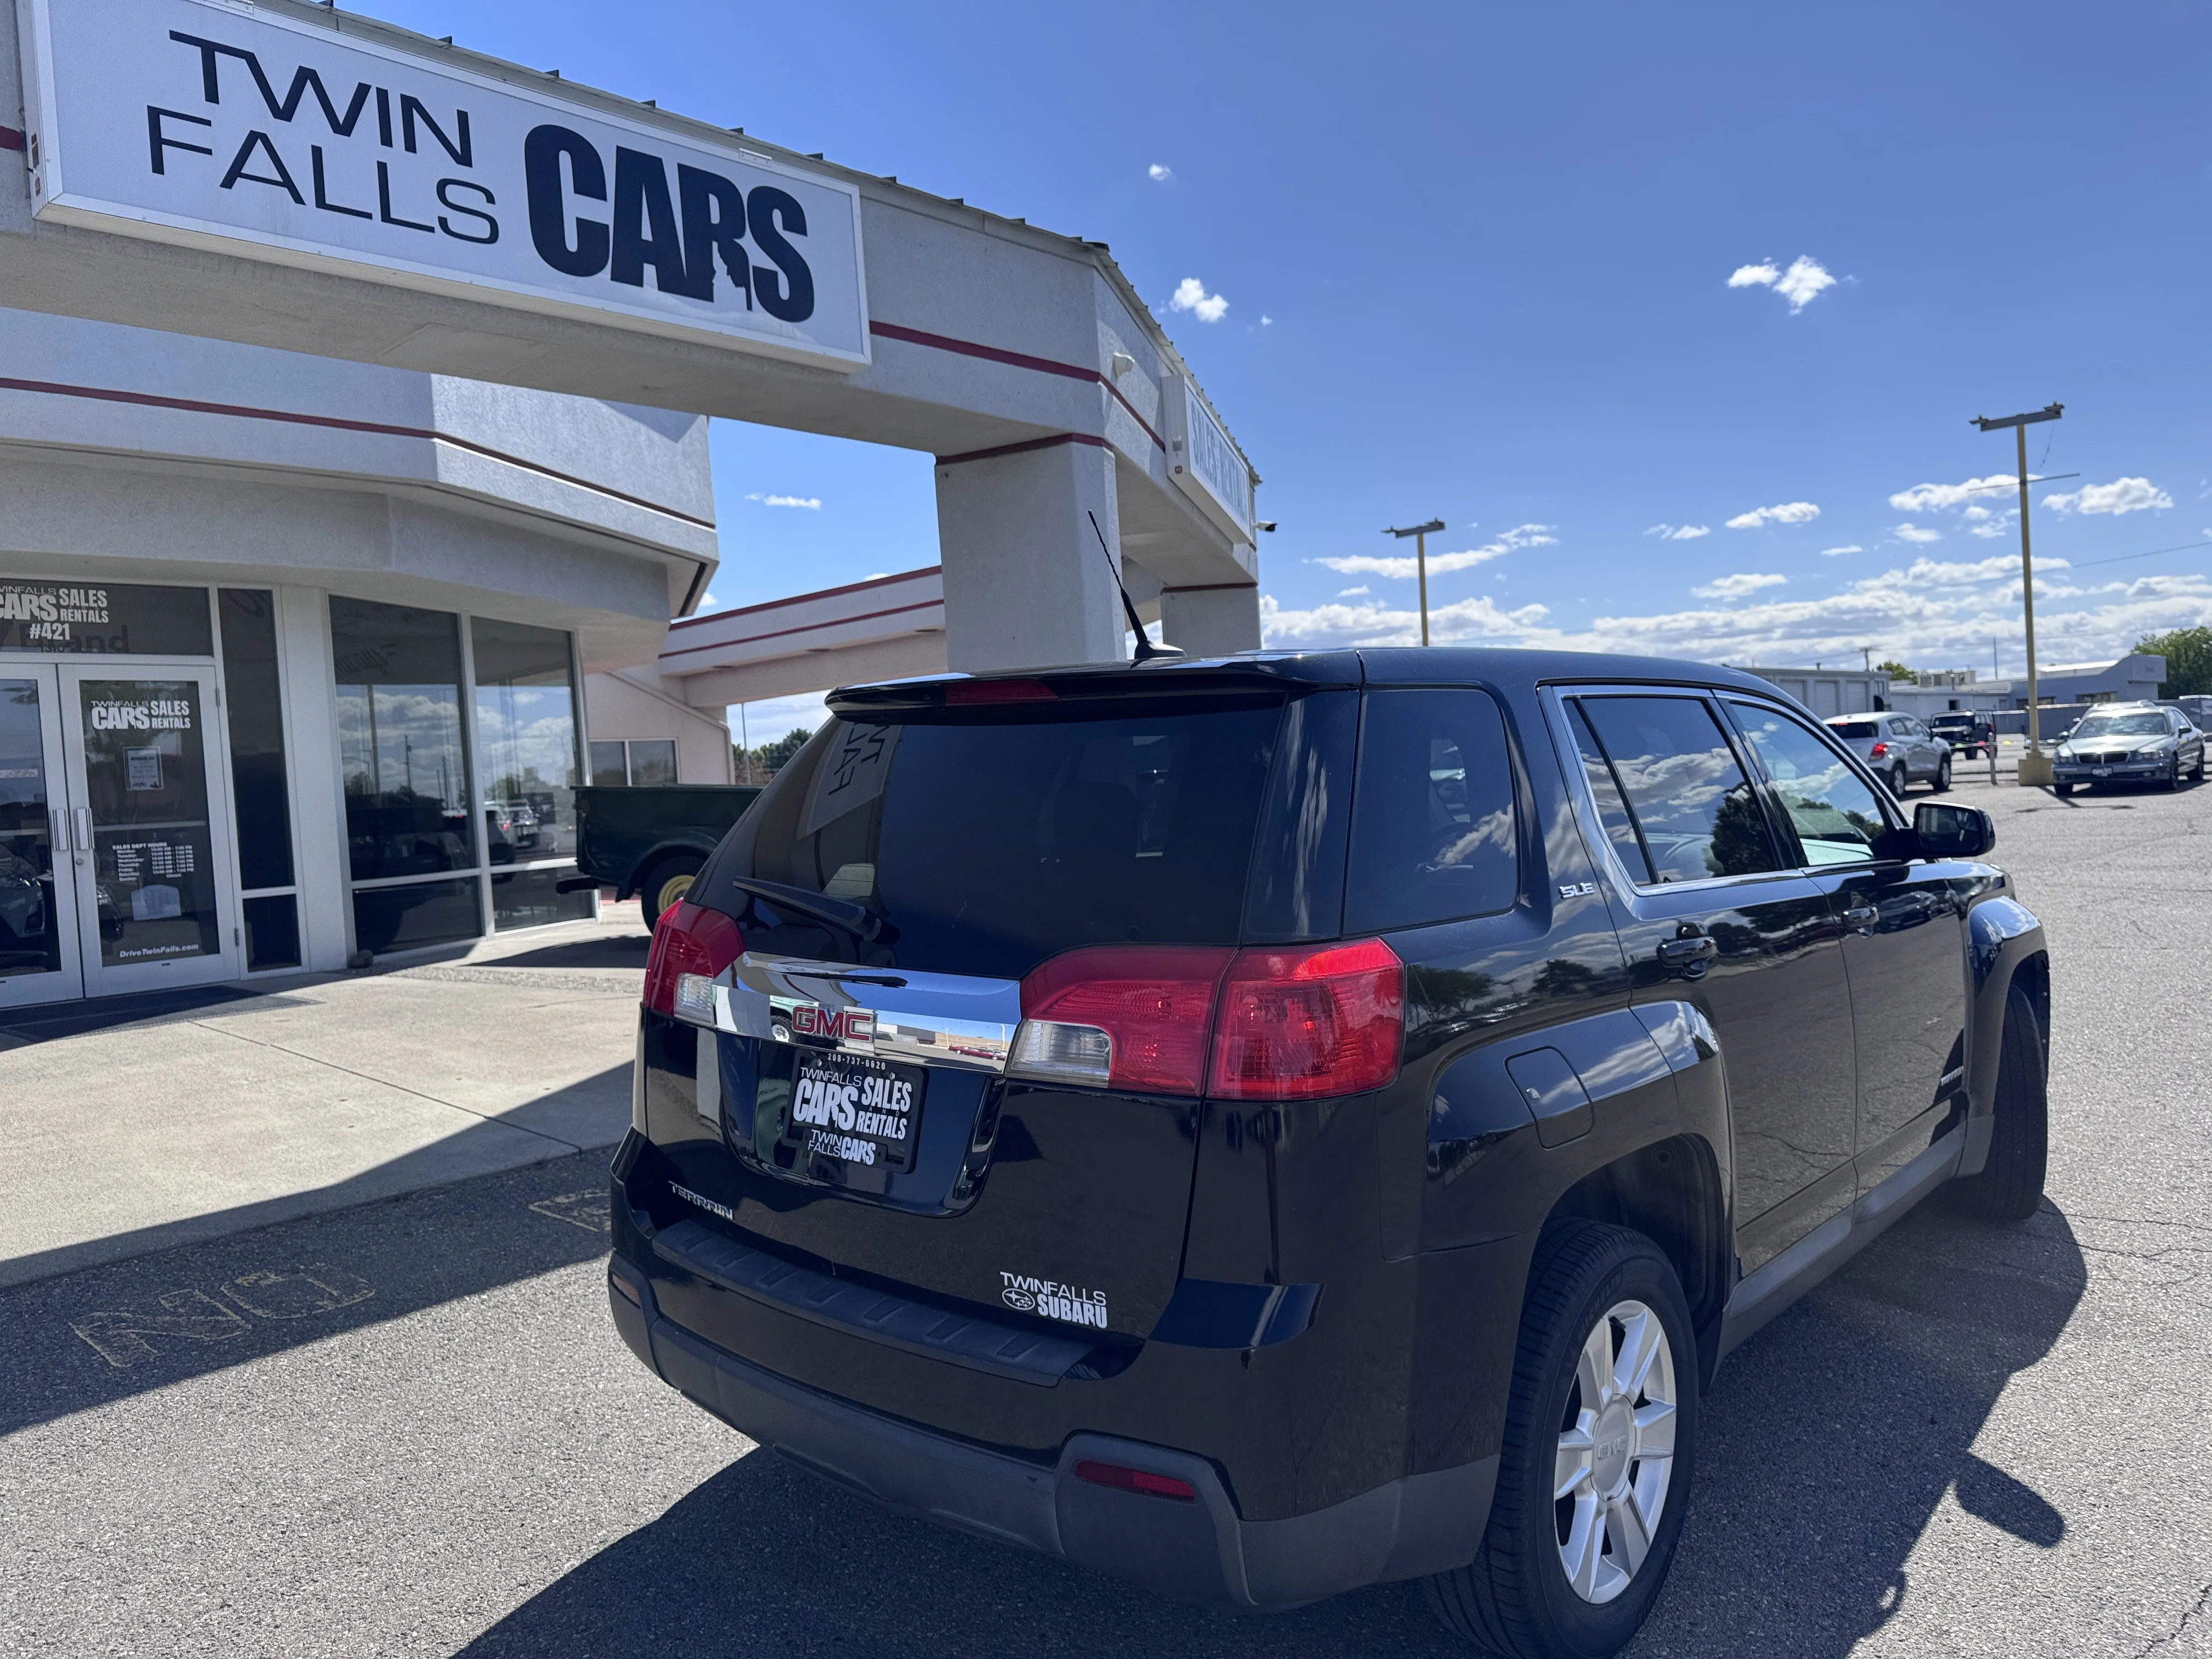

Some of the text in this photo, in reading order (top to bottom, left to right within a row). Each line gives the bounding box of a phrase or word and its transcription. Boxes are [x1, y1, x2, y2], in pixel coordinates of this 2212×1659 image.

[169, 30, 473, 168] TWIN
[147, 105, 500, 245] FALLS
[524, 124, 814, 323] CARS
[1191, 400, 1218, 489] SALES
[0, 592, 58, 622] ARS
[59, 588, 108, 608] SALES
[60, 608, 109, 624] RENTALS
[29, 622, 70, 641] #421
[91, 707, 150, 730] CARS
[150, 700, 189, 716] SALES
[151, 717, 191, 729] RENTALS
[1559, 882, 1594, 899] SLE
[120, 944, 199, 958] DriveTwinFalls.com
[792, 1006, 874, 1042] GMC
[828, 1053, 886, 1070] 208-737-6620
[800, 1067, 862, 1087] TWINFALLS
[793, 1079, 859, 1131] CARS
[861, 1076, 912, 1112] SALES
[811, 1129, 843, 1147] TWIN
[856, 1110, 907, 1140] RENTALS
[808, 1140, 841, 1157] FALLS
[840, 1137, 876, 1165] CARS
[668, 1180, 733, 1221] TERRAIN
[1000, 1271, 1107, 1306] TWINFALLS
[1037, 1294, 1107, 1328] SUBARU
[1598, 1435, 1626, 1460] GMC
